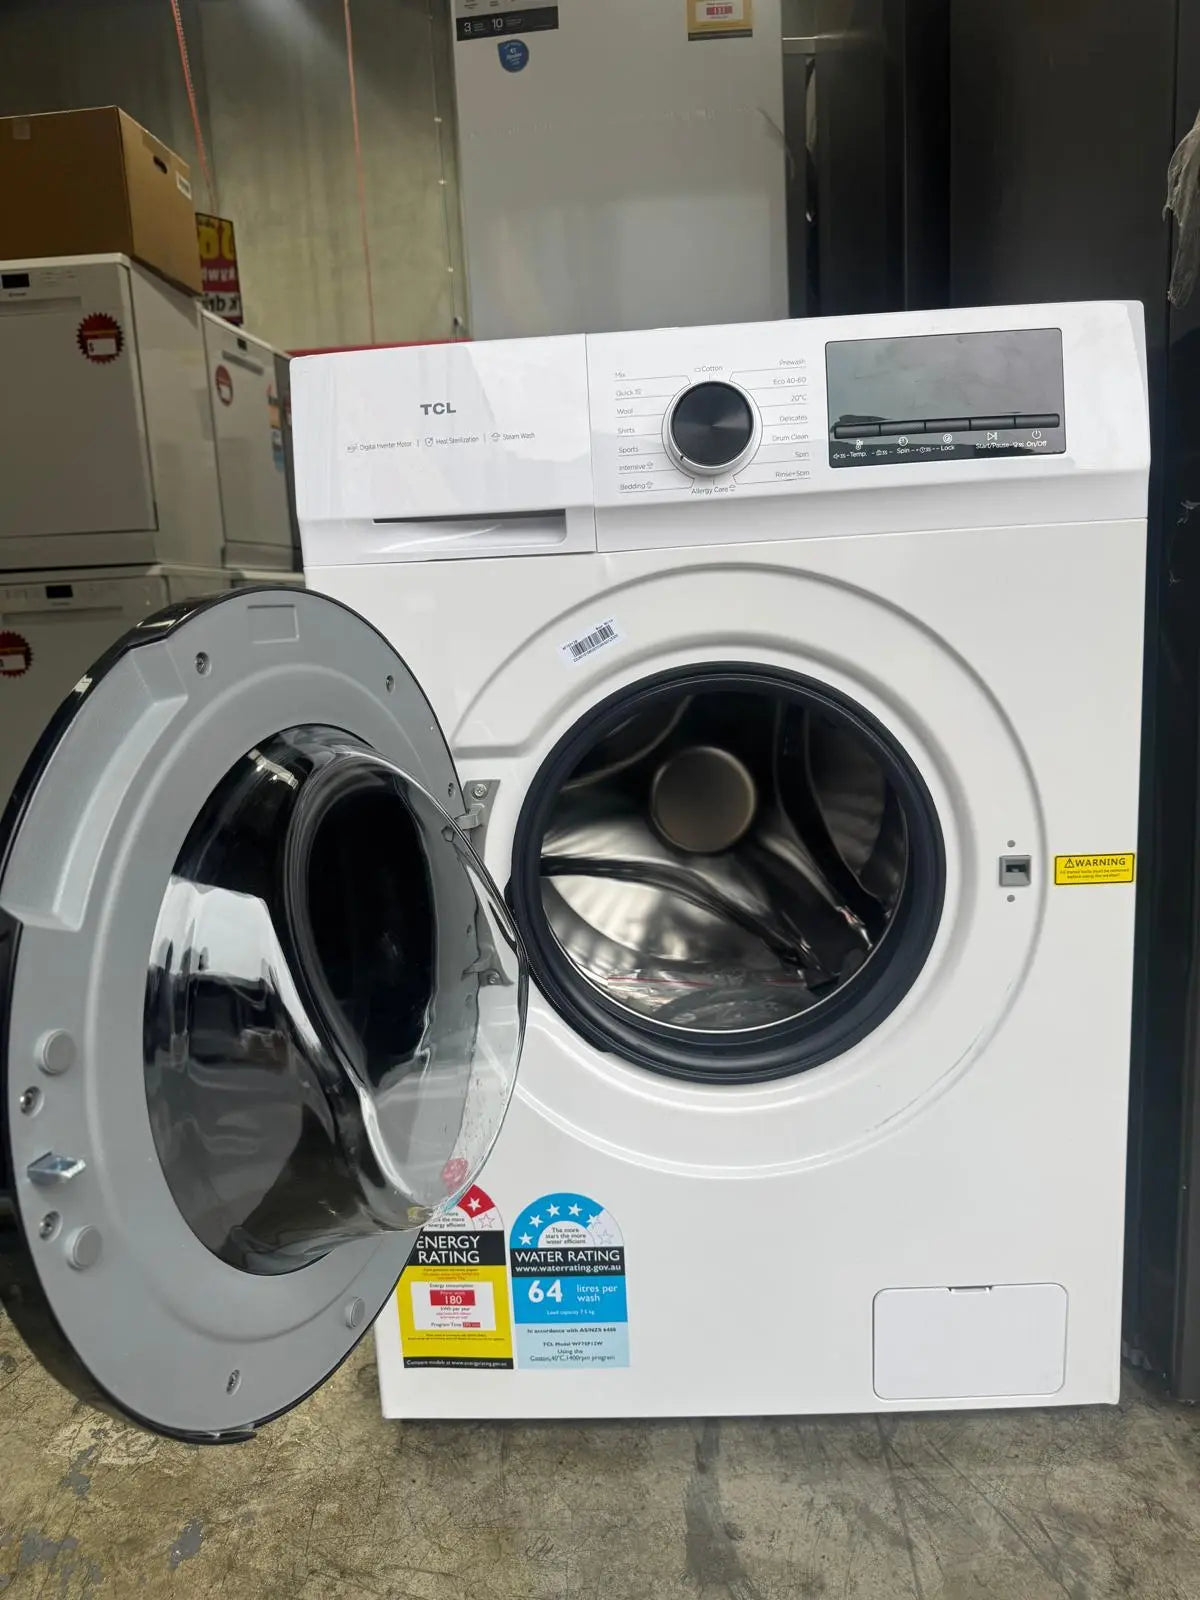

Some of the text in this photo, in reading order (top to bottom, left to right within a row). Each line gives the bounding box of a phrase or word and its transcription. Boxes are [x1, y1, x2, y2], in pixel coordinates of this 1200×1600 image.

[492, 18, 503, 29] 10
[786, 376, 807, 384] 40-60
[791, 394, 807, 402] 20°C
[420, 402, 456, 416] TCL
[448, 435, 480, 444] Sterilization
[360, 444, 376, 452] Digital
[976, 442, 1010, 450] Start/Pause
[1026, 440, 1047, 448] On/Off
[620, 482, 646, 491] Bedding
[691, 487, 712, 495] Allergy
[1075, 857, 1126, 867] WARNING
[416, 1235, 480, 1249] ENERGY
[418, 1250, 480, 1264] RATING
[515, 1250, 620, 1263] WATER RATING
[515, 1264, 622, 1274] www.waterrating.gov.au
[528, 1278, 618, 1303] 64 litres per
[445, 1295, 463, 1304] 180
[576, 1294, 600, 1302] wash
